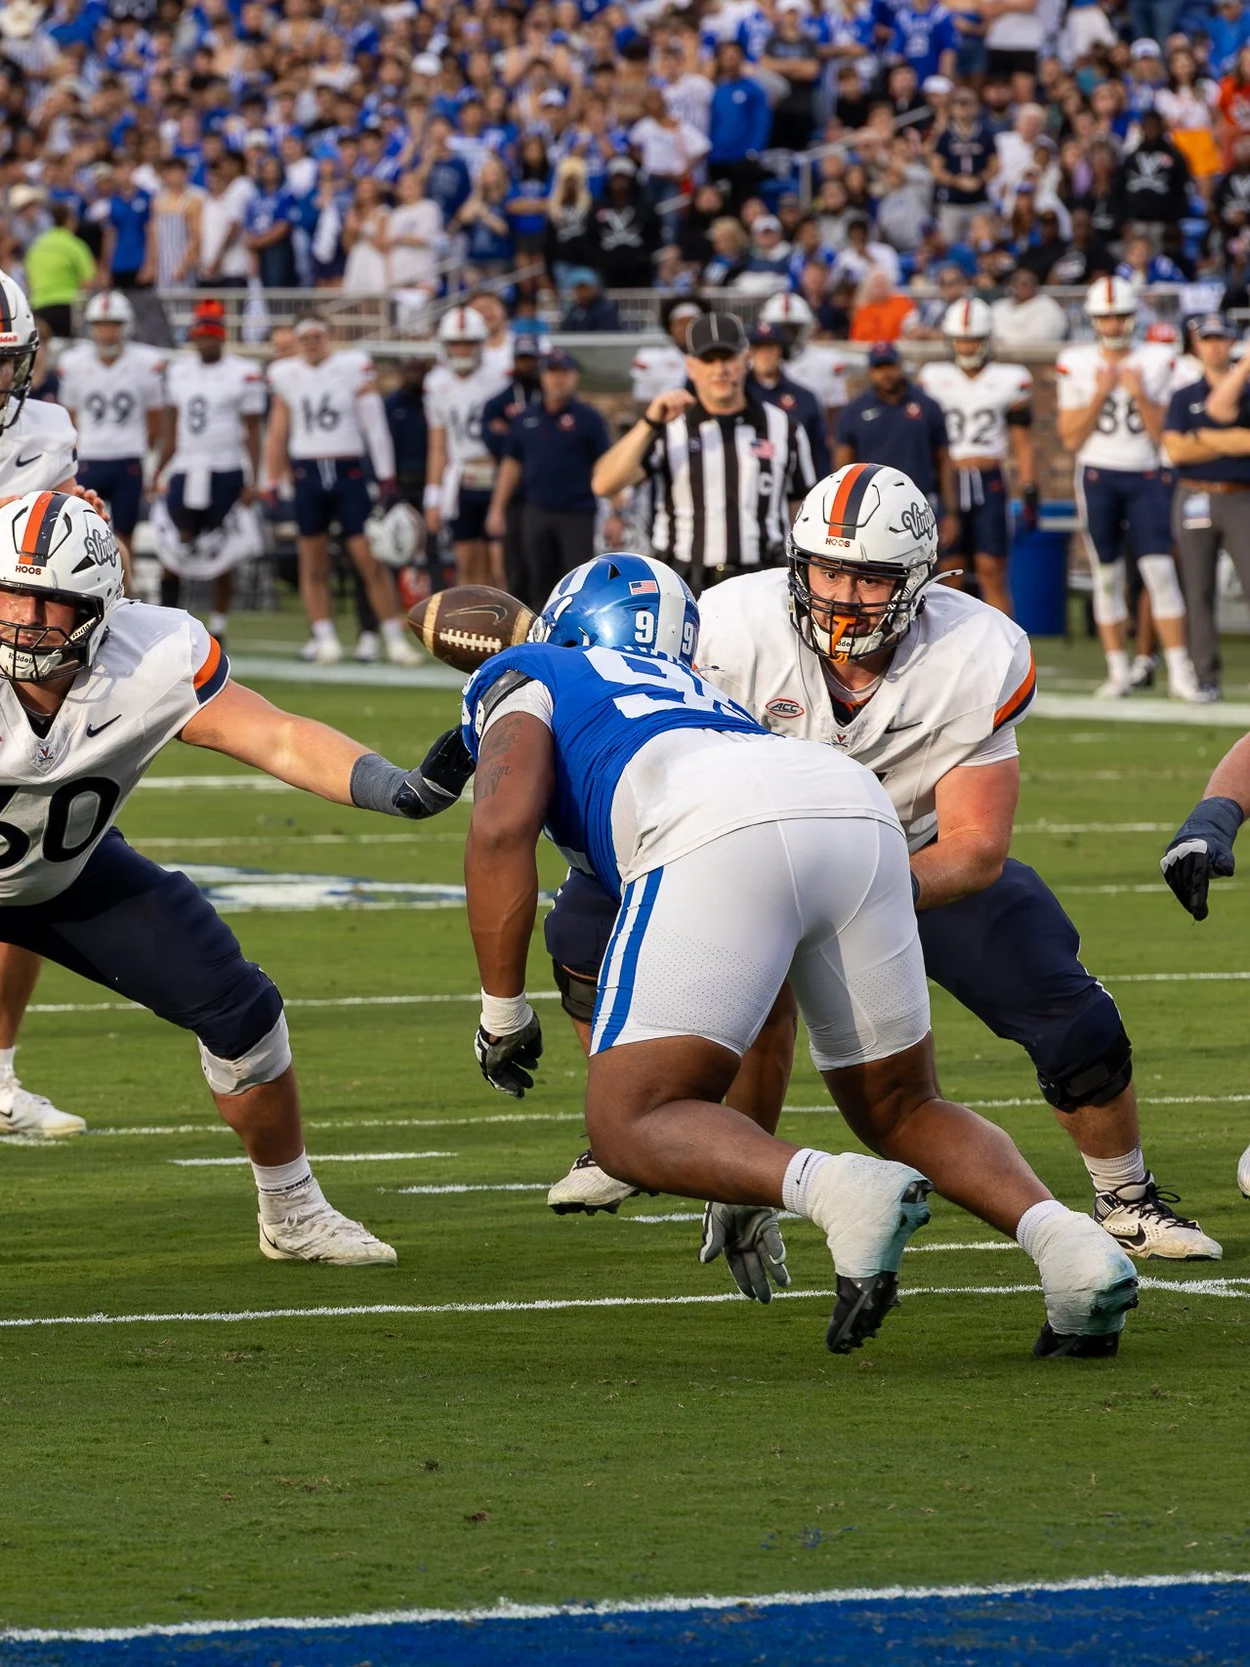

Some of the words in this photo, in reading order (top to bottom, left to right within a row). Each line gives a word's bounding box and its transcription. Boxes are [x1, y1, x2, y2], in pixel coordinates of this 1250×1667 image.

[85, 391, 135, 425] 99
[303, 393, 340, 432] 16
[901, 501, 936, 540] Virg
[84, 529, 119, 567] Virg
[825, 537, 851, 548] HOOS
[15, 565, 42, 575] HOOS
[635, 610, 655, 643] 9
[682, 622, 694, 655] 9
[8, 652, 35, 664] Rddell
[770, 702, 799, 714] ACC
